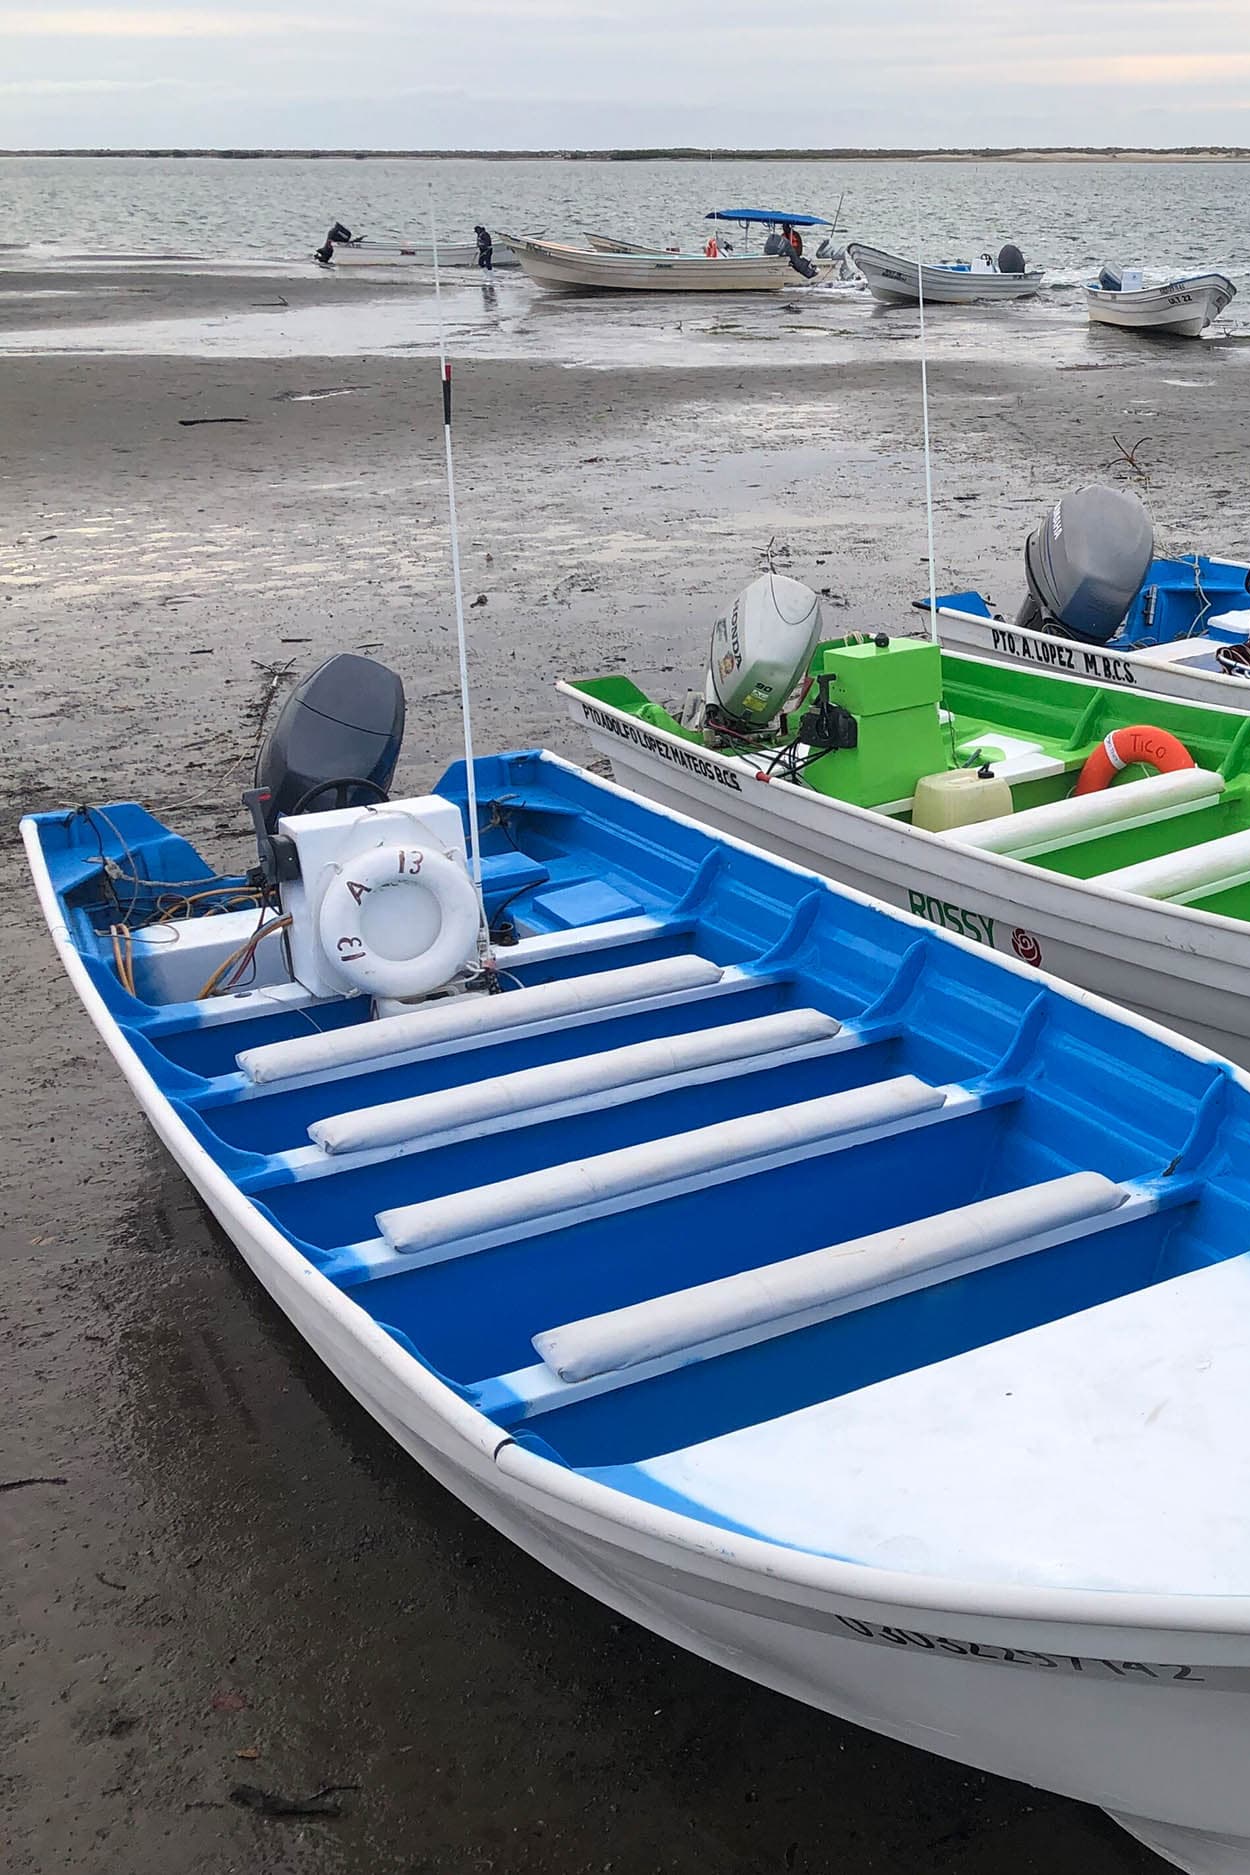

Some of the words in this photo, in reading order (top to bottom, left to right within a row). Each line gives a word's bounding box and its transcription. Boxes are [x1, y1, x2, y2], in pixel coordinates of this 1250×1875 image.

[732, 597, 742, 671] HONDA
[991, 629, 1020, 657] PTO.
[600, 711, 639, 744] ADOLFO
[636, 728, 673, 761] LOPEZ
[670, 745, 715, 780] MATEOS
[346, 878, 372, 907] A
[398, 849, 425, 875] 13
[908, 888, 997, 949] ROSSY
